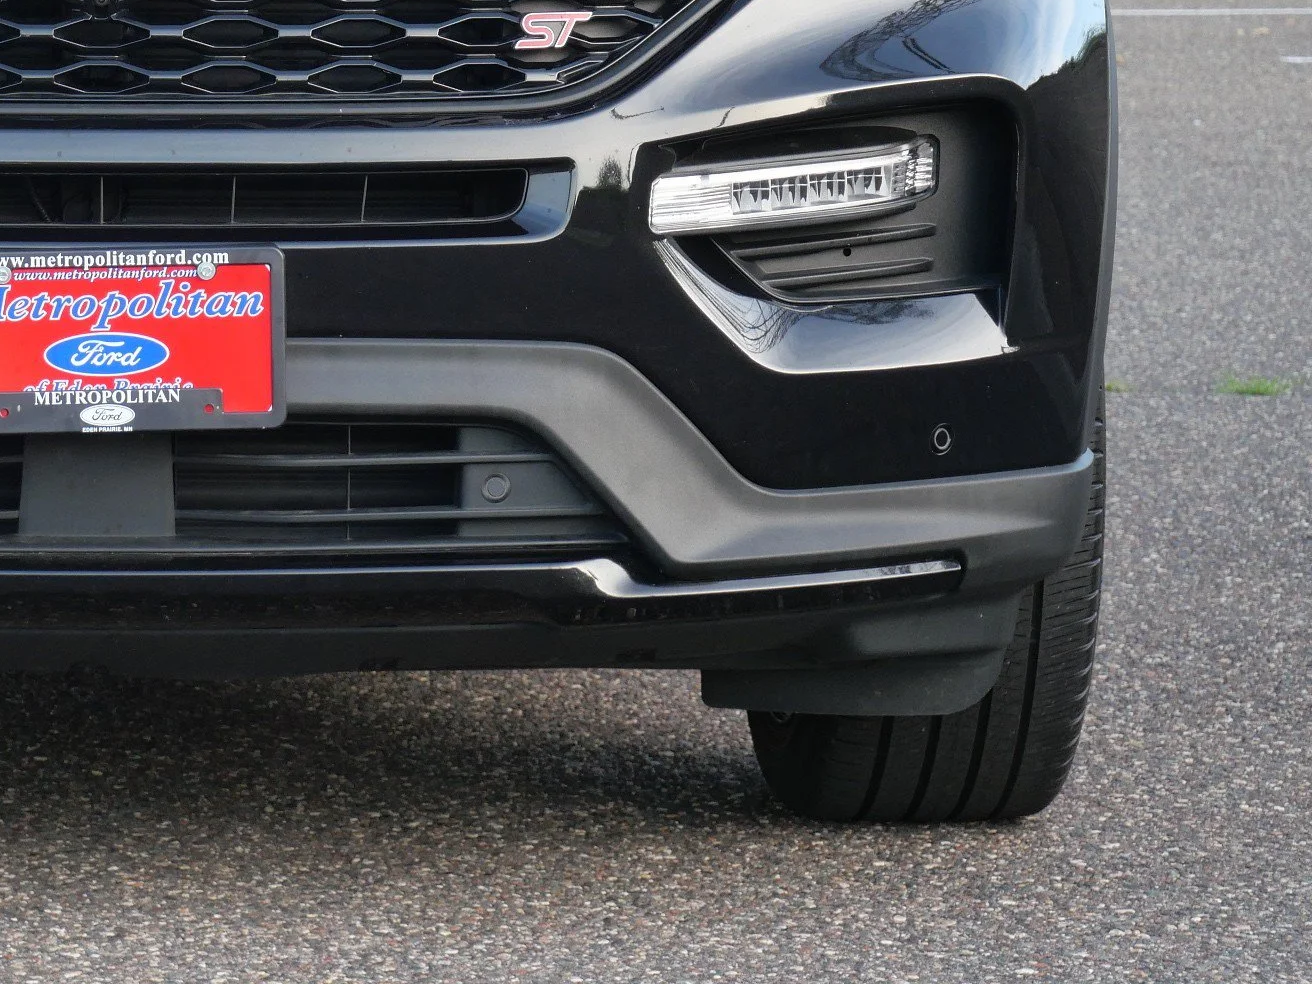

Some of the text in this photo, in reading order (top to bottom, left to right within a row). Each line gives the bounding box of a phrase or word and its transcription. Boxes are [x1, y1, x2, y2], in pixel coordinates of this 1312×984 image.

[515, 11, 592, 50] ST
[14, 267, 197, 282] www.metropolitanford.com
[70, 339, 142, 366] Ford
[34, 389, 181, 405] METROPOLITAN
[91, 407, 123, 420] Ford
